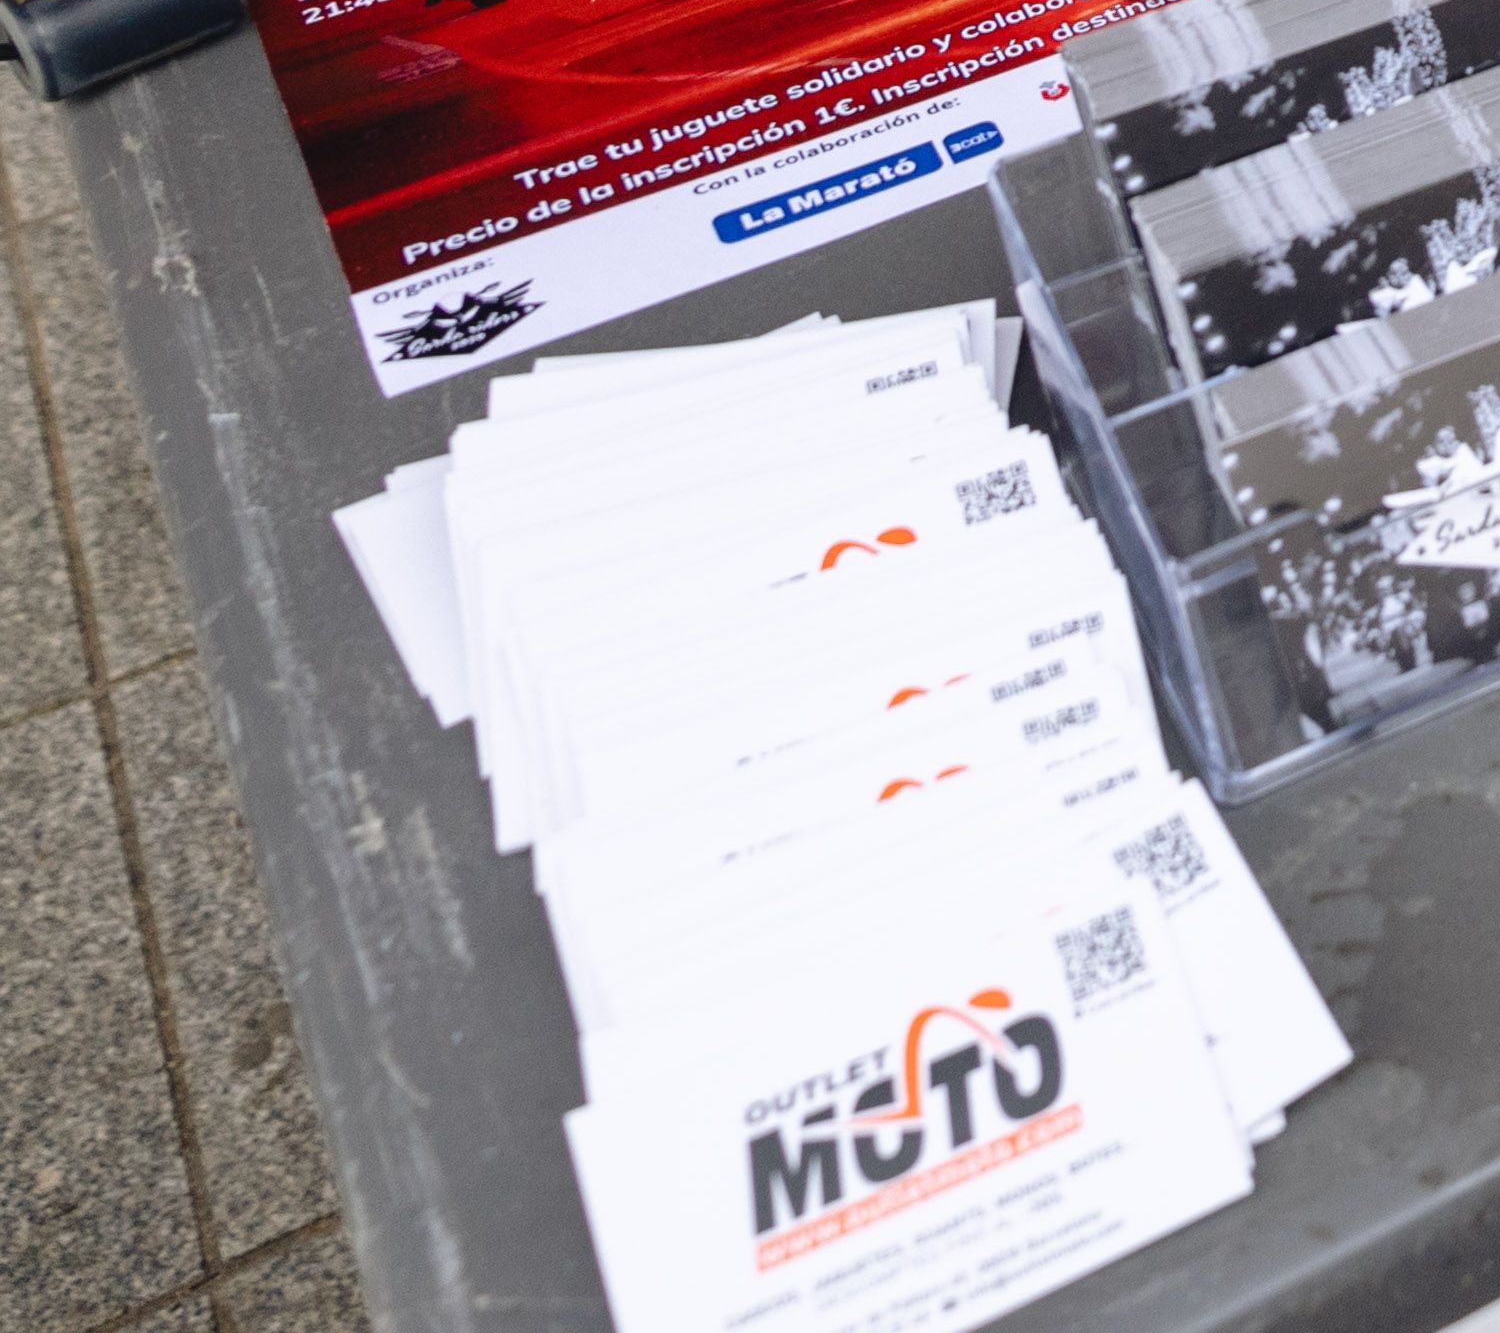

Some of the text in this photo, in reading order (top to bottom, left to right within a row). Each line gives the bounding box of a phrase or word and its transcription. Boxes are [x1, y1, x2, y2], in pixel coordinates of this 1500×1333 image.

[514, 155, 597, 188] Trae
[606, 139, 643, 159] tu
[650, 94, 778, 150] juguete
[787, 45, 925, 99] solidario
[933, 34, 951, 53] y
[740, 202, 786, 233] La
[789, 155, 917, 220] Marató
[744, 1046, 892, 1125] OUTLET
[749, 1012, 1064, 1235] MOTO
